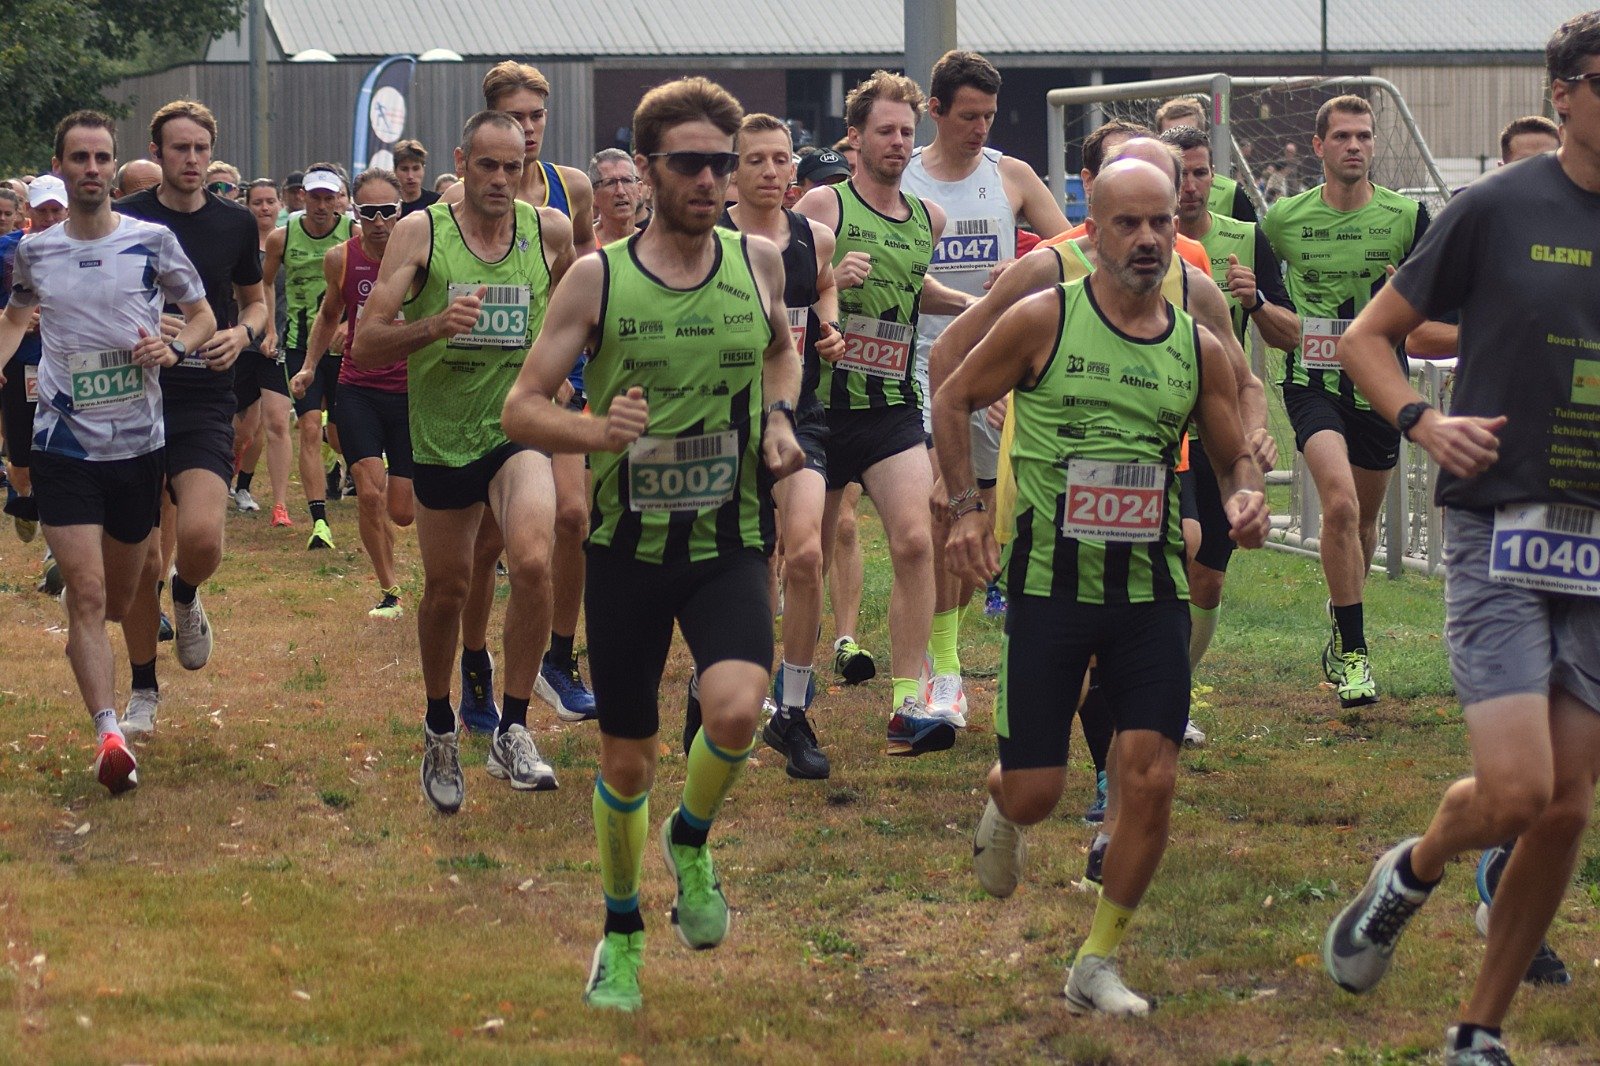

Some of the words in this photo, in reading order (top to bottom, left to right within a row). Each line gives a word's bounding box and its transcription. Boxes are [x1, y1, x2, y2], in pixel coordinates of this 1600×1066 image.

[884, 240, 911, 250] Athlex
[1218, 231, 1245, 240] BIORACER
[934, 239, 994, 260] 1047
[1530, 244, 1593, 267] GLENN
[717, 281, 751, 301] BIORACER
[473, 309, 525, 333] 003
[675, 326, 715, 338] Athlex
[1547, 333, 1576, 347] Boost
[844, 338, 903, 368] 2021
[1305, 338, 1336, 359] 20
[1087, 365, 1110, 374] press
[77, 368, 139, 397] 3014
[1120, 374, 1159, 391] Athlex
[1551, 444, 1594, 458] Reinigen
[637, 462, 733, 496] 3002
[1072, 491, 1159, 524] 2024
[1073, 527, 1155, 539] www.krekenlopers.be
[1501, 534, 1600, 577] 1040
[1500, 575, 1598, 592] www.krekenlopers.be
